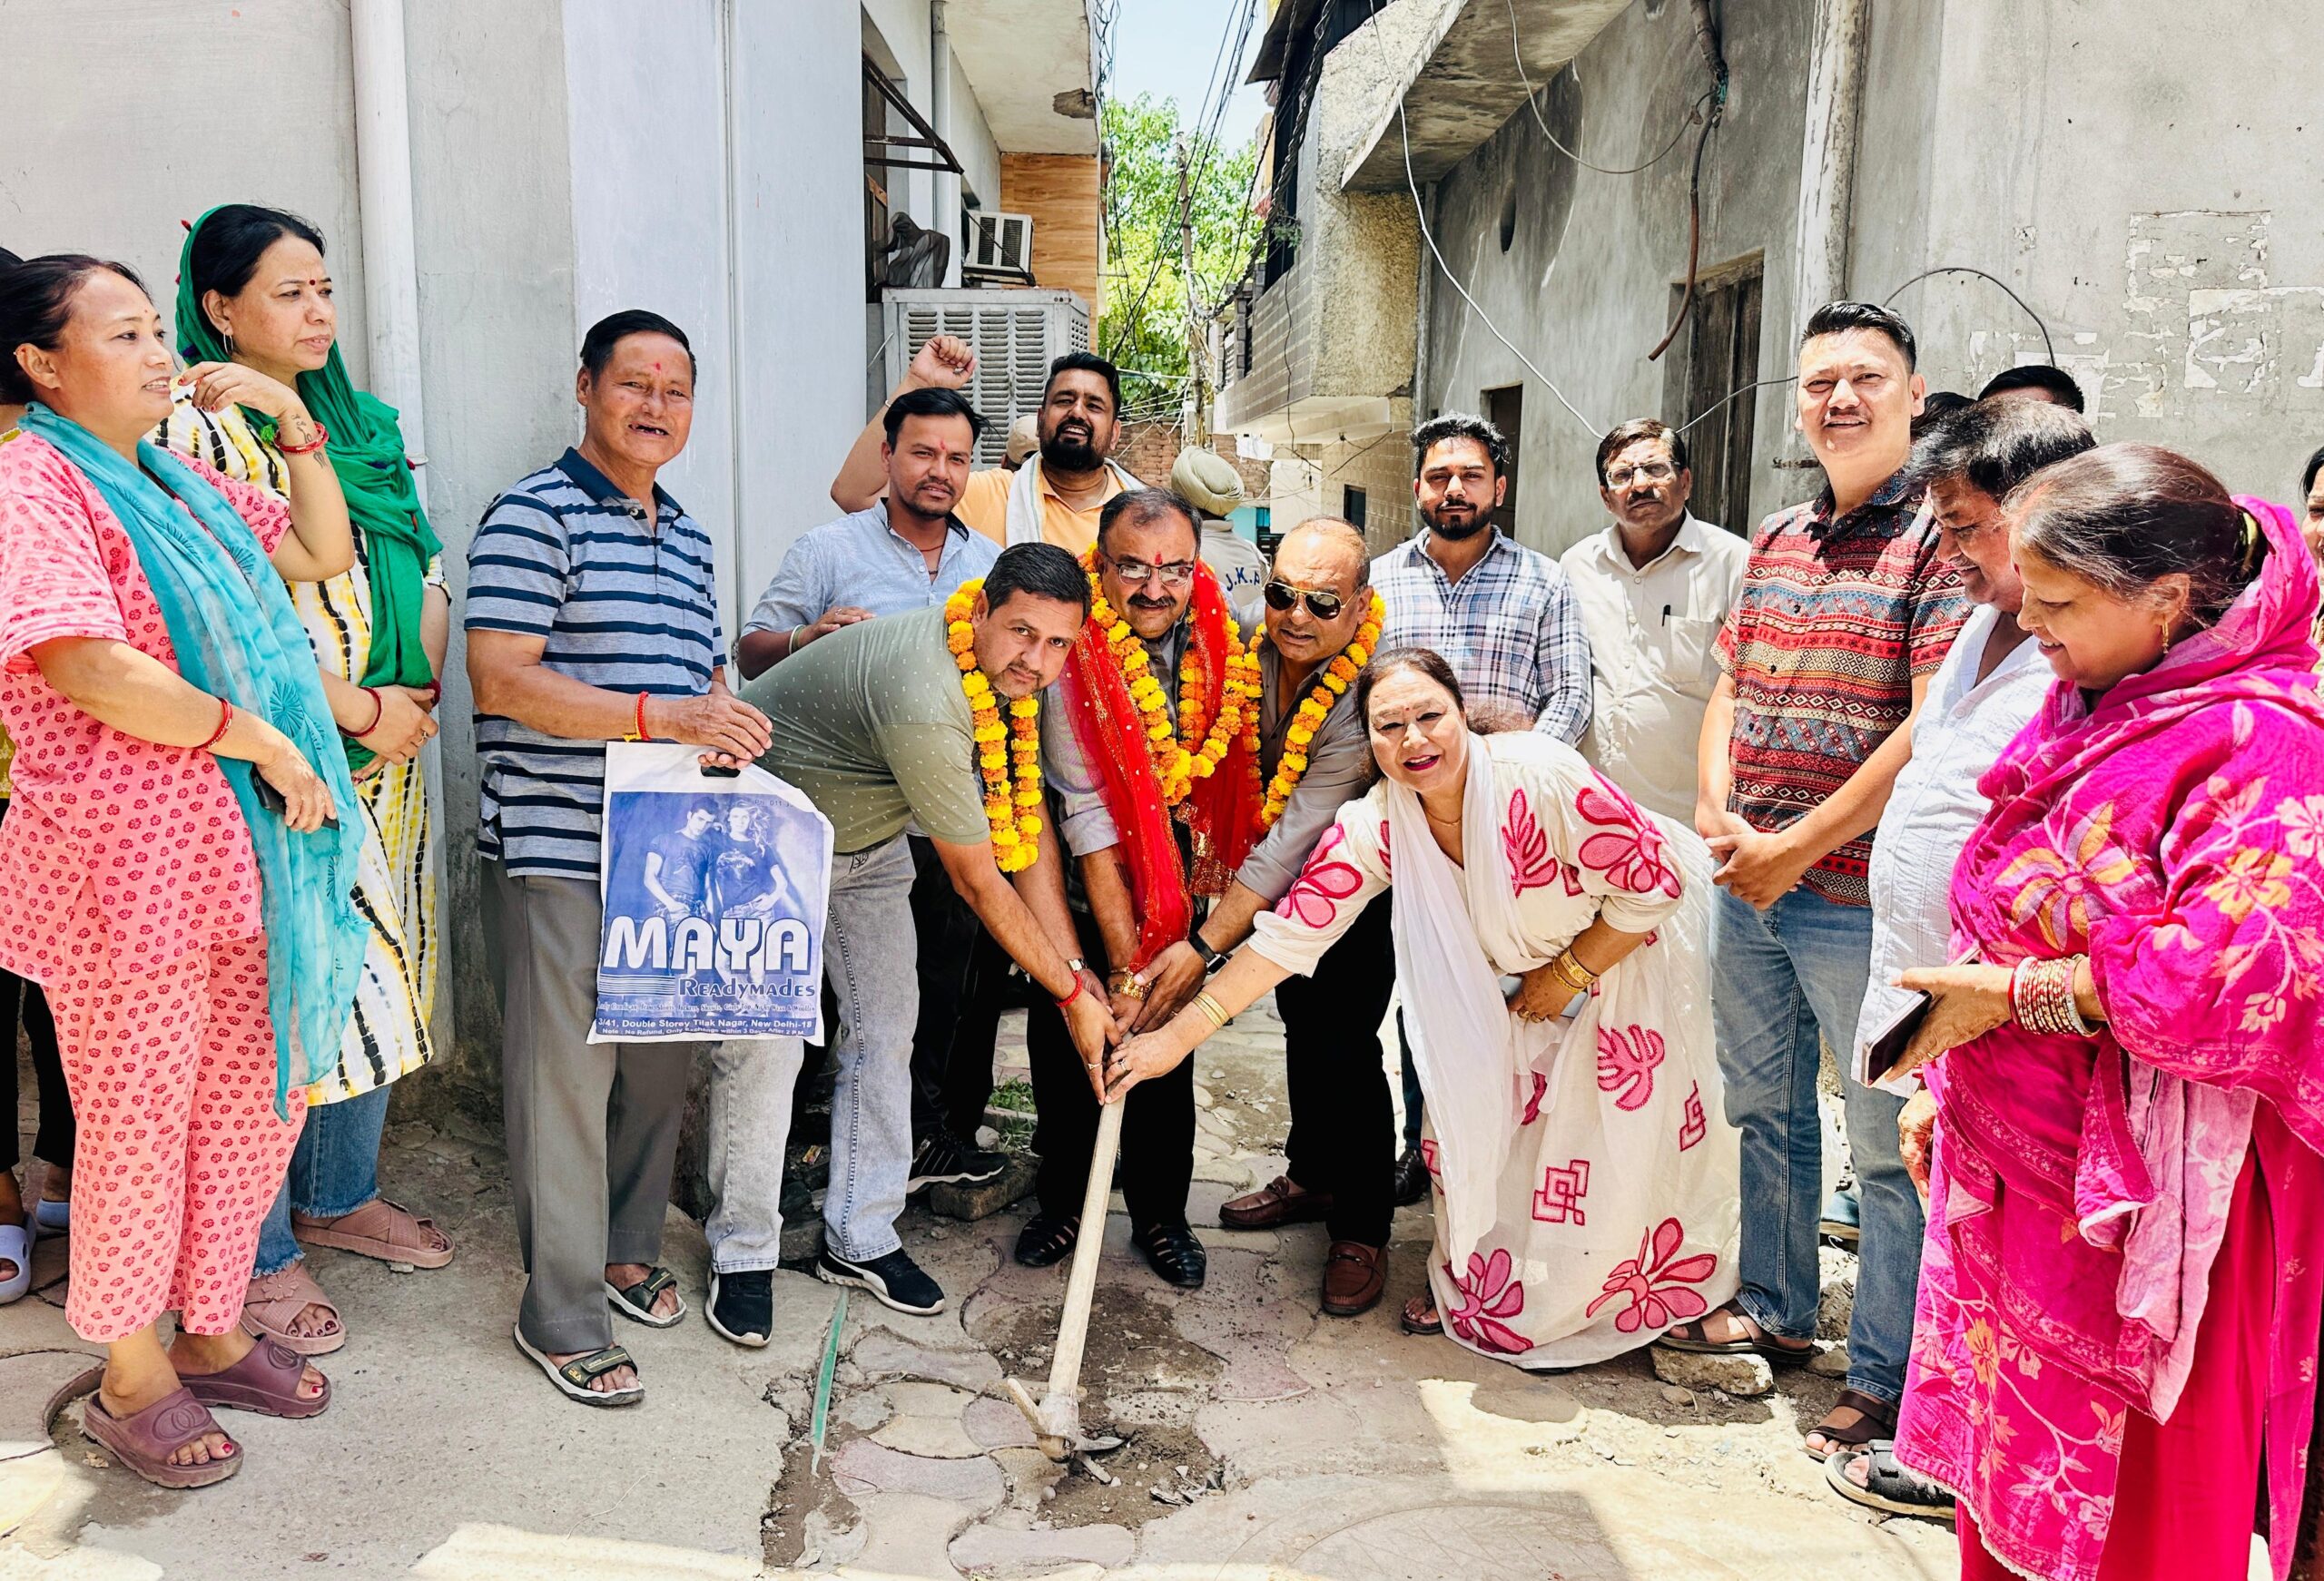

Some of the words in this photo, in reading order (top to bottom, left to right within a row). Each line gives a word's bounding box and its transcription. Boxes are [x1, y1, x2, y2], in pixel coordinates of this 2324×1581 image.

[601, 916, 811, 974] MAYA
[622, 1019, 656, 1027] Double
[659, 1019, 690, 1029] Storey
[718, 1019, 749, 1029] Nagar,
[751, 1019, 771, 1027] New
